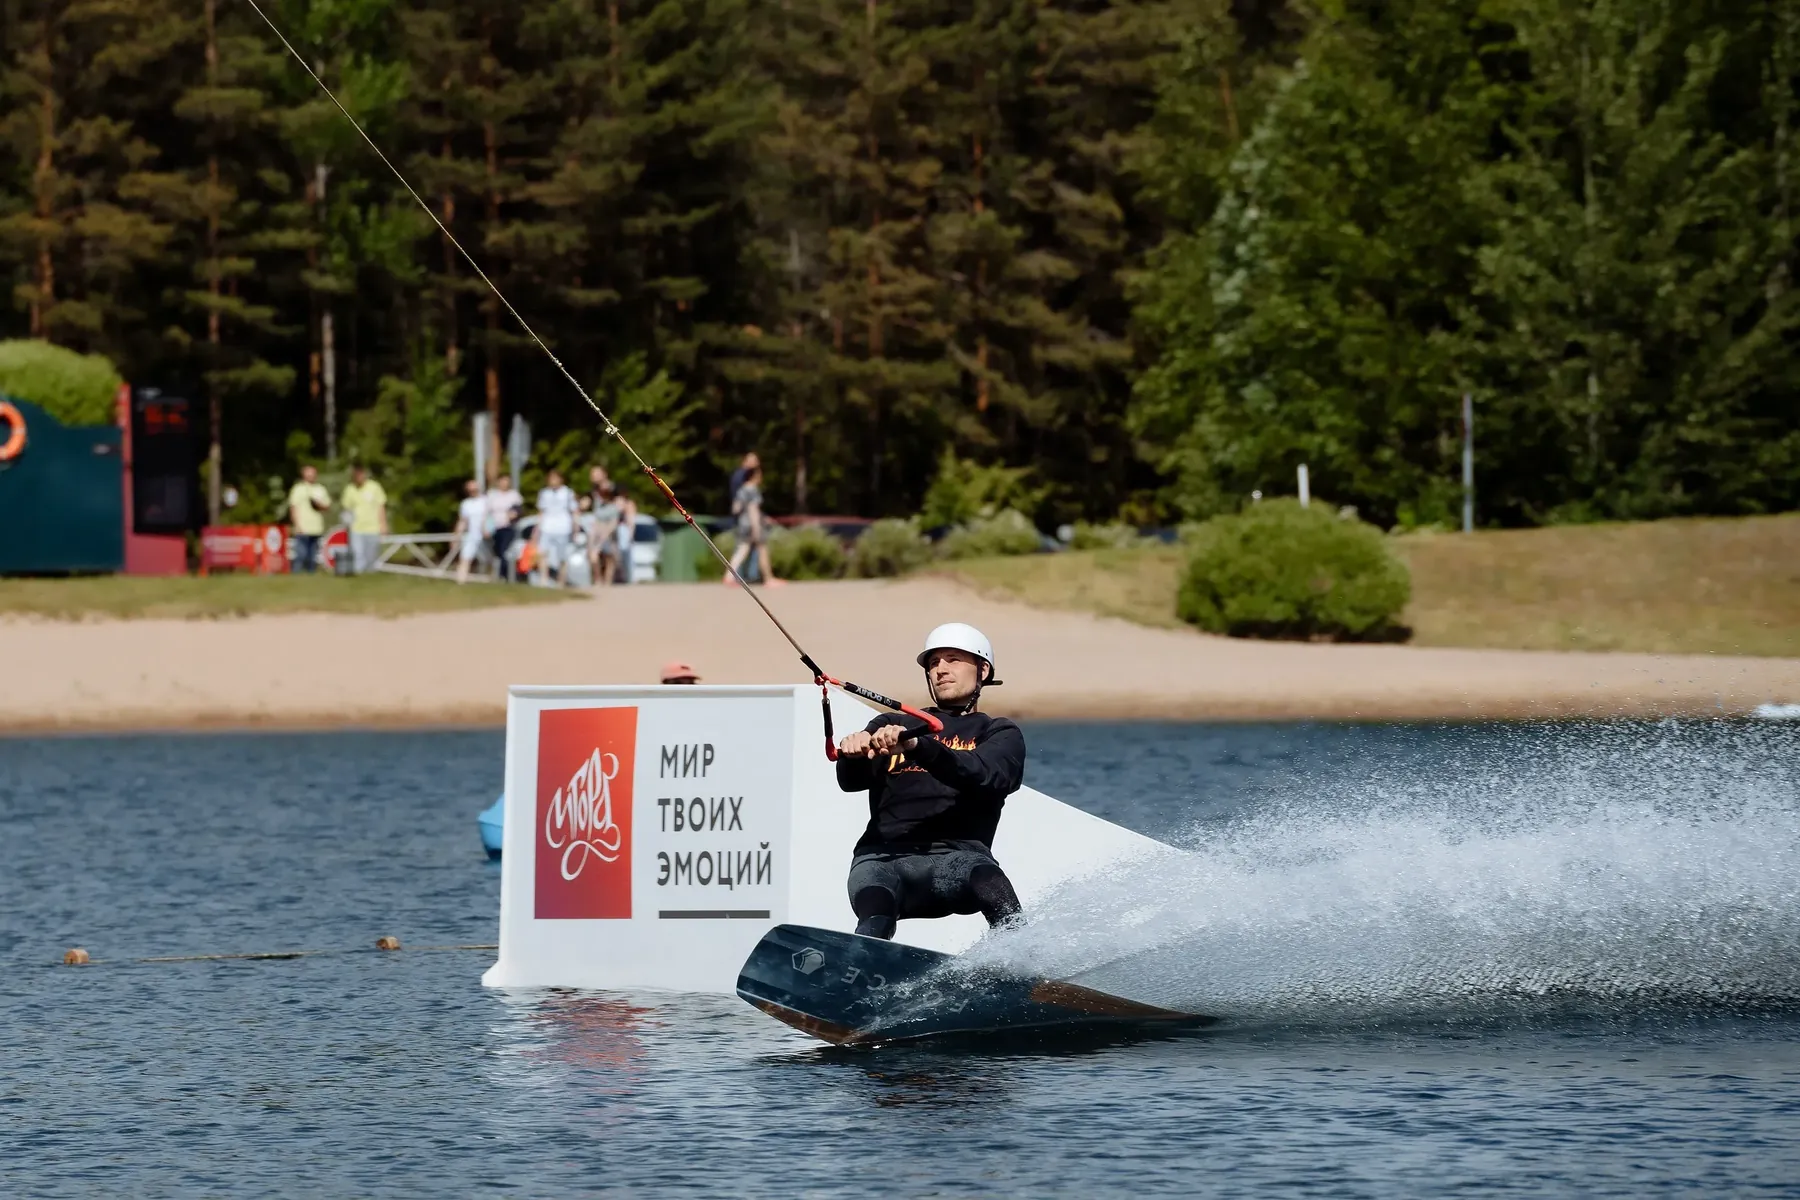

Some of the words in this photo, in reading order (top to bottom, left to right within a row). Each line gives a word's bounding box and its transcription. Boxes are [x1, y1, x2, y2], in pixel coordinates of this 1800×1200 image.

[660, 743, 715, 778] МИР
[657, 797, 743, 832] ТВОИХ
[657, 841, 772, 890] ЭМОЦИЙ
